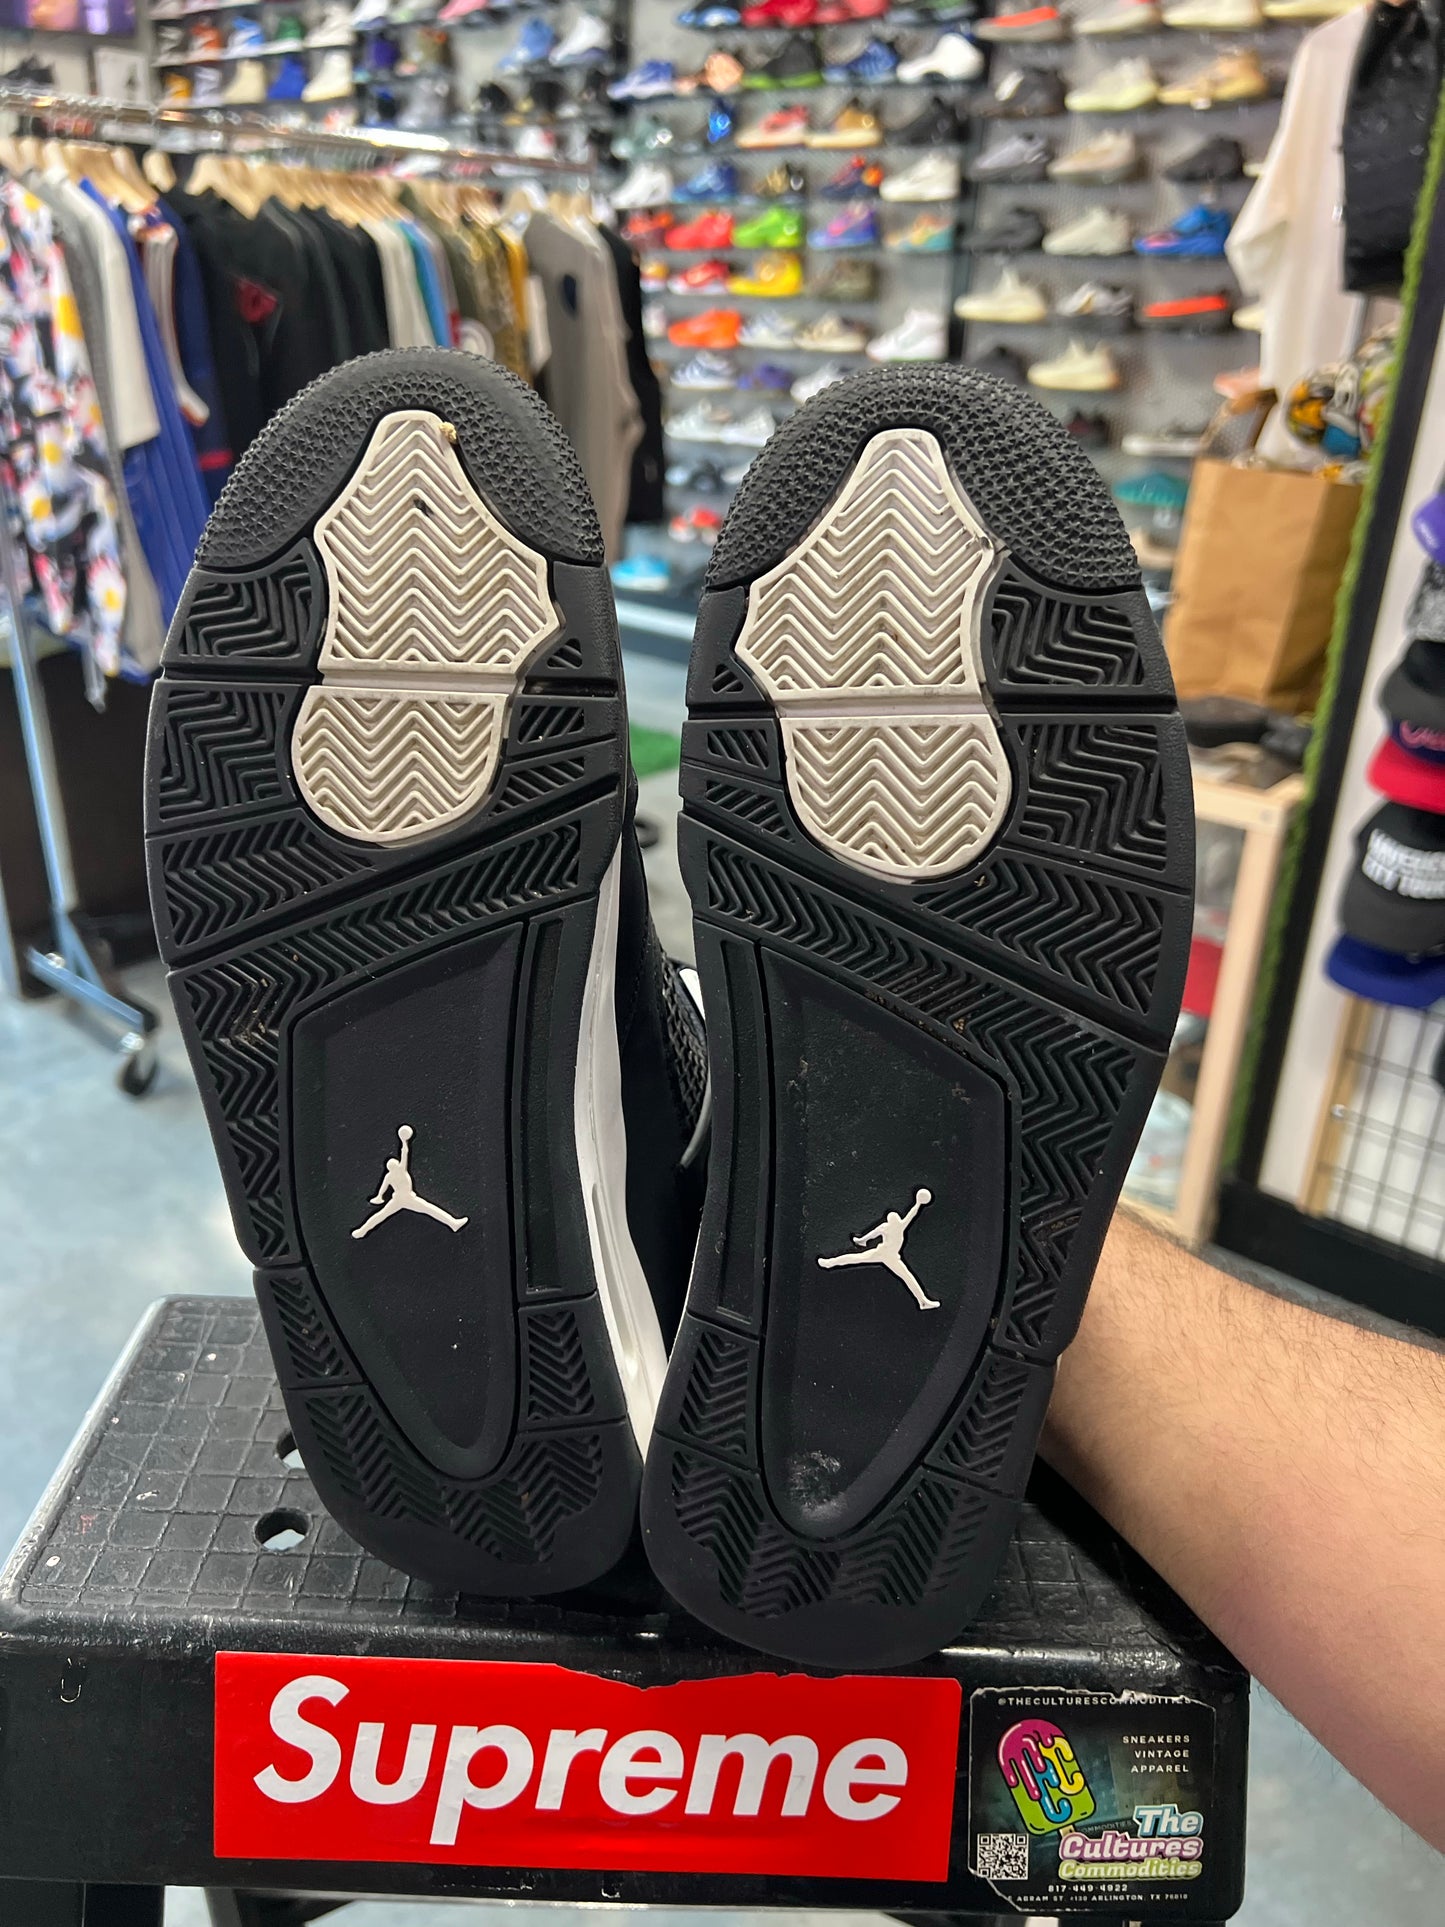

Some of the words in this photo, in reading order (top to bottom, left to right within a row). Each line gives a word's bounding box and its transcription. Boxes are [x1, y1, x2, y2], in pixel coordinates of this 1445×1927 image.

[1122, 1735, 1190, 1744] SNEAKERS
[253, 1675, 908, 1845] Supreme
[1134, 1750, 1189, 1758] VINTAGE
[1130, 1765, 1189, 1773] APPAREL
[1136, 1806, 1200, 1835] The
[1062, 1834, 1201, 1860] Cultures
[1060, 1859, 1200, 1879] Commodities
